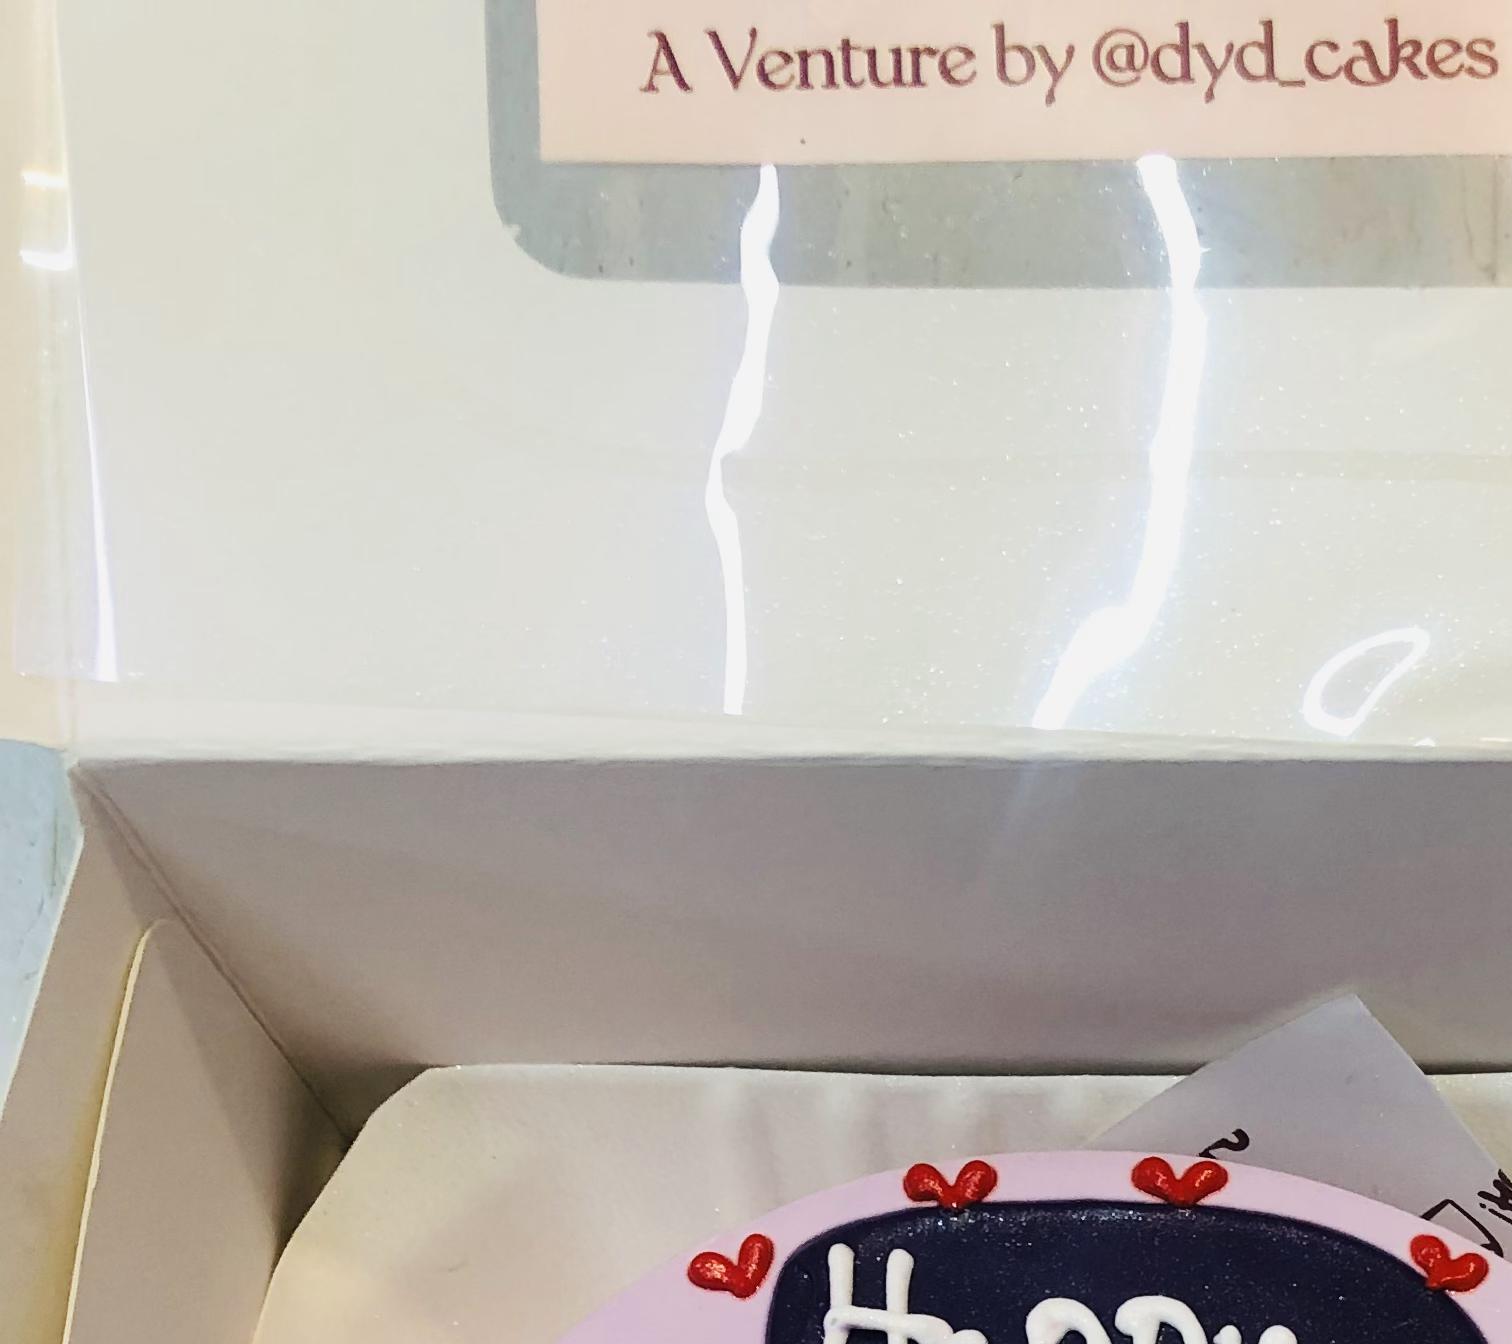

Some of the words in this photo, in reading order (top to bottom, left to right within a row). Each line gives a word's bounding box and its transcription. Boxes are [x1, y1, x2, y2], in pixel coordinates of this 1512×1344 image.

[639, 30, 693, 94] A
[706, 27, 976, 90] Venture
[993, 23, 1075, 105] by
[1093, 17, 1500, 103] @dyd_cakes
